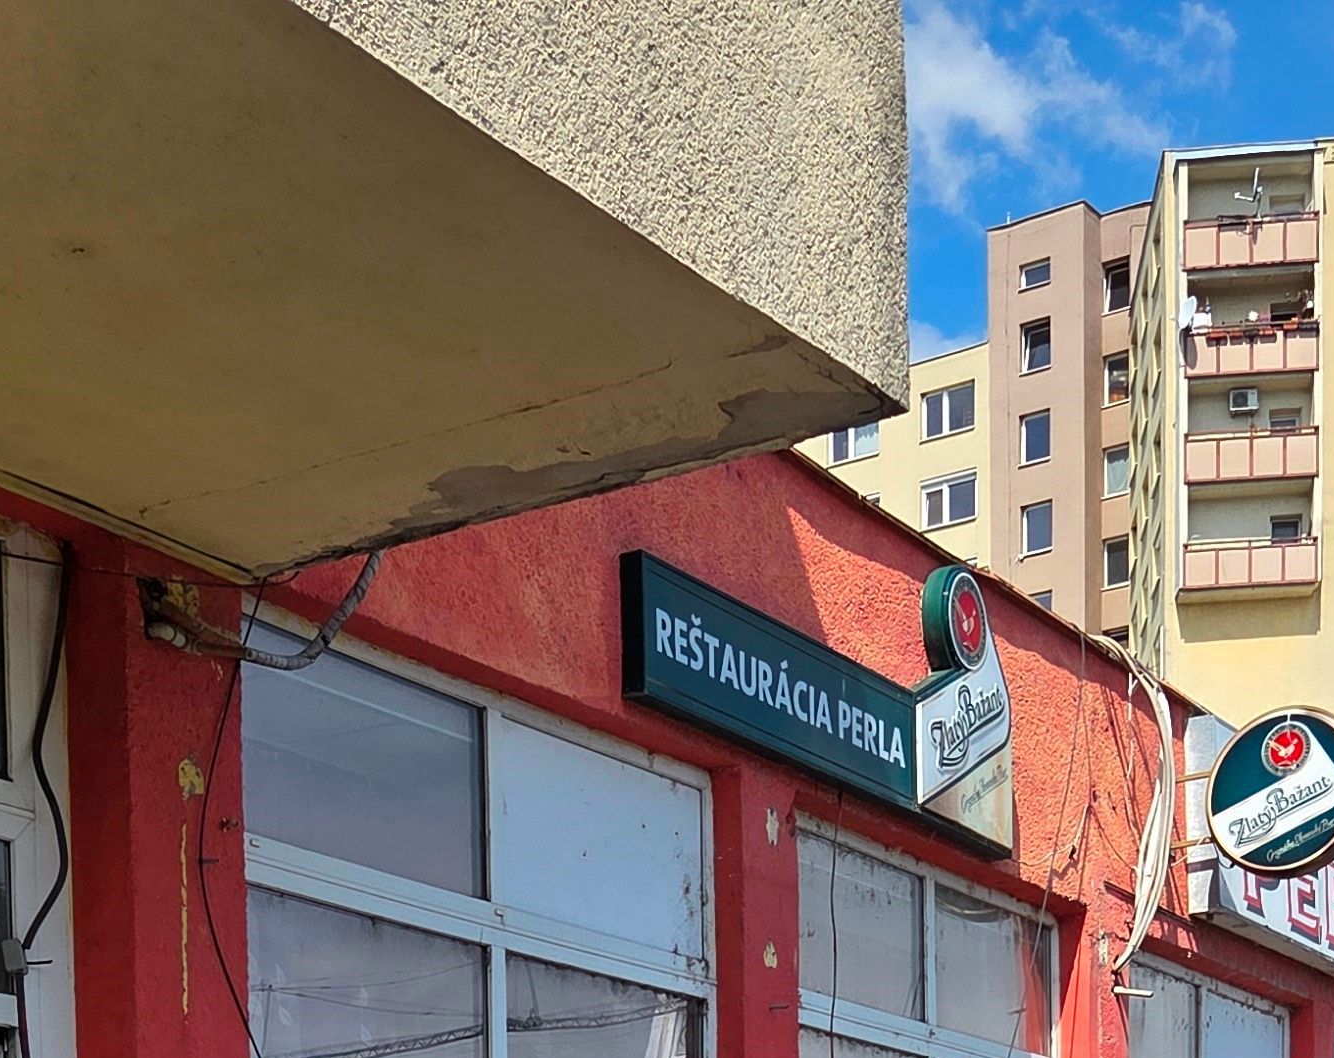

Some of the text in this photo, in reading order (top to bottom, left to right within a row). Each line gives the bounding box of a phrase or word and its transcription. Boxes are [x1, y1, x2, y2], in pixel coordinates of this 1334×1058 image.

[655, 607, 833, 735] REŠTAURÁCIA
[838, 699, 906, 769] PERLA
[1228, 804, 1276, 849] Zlatý
[1266, 775, 1333, 813] Bažant
